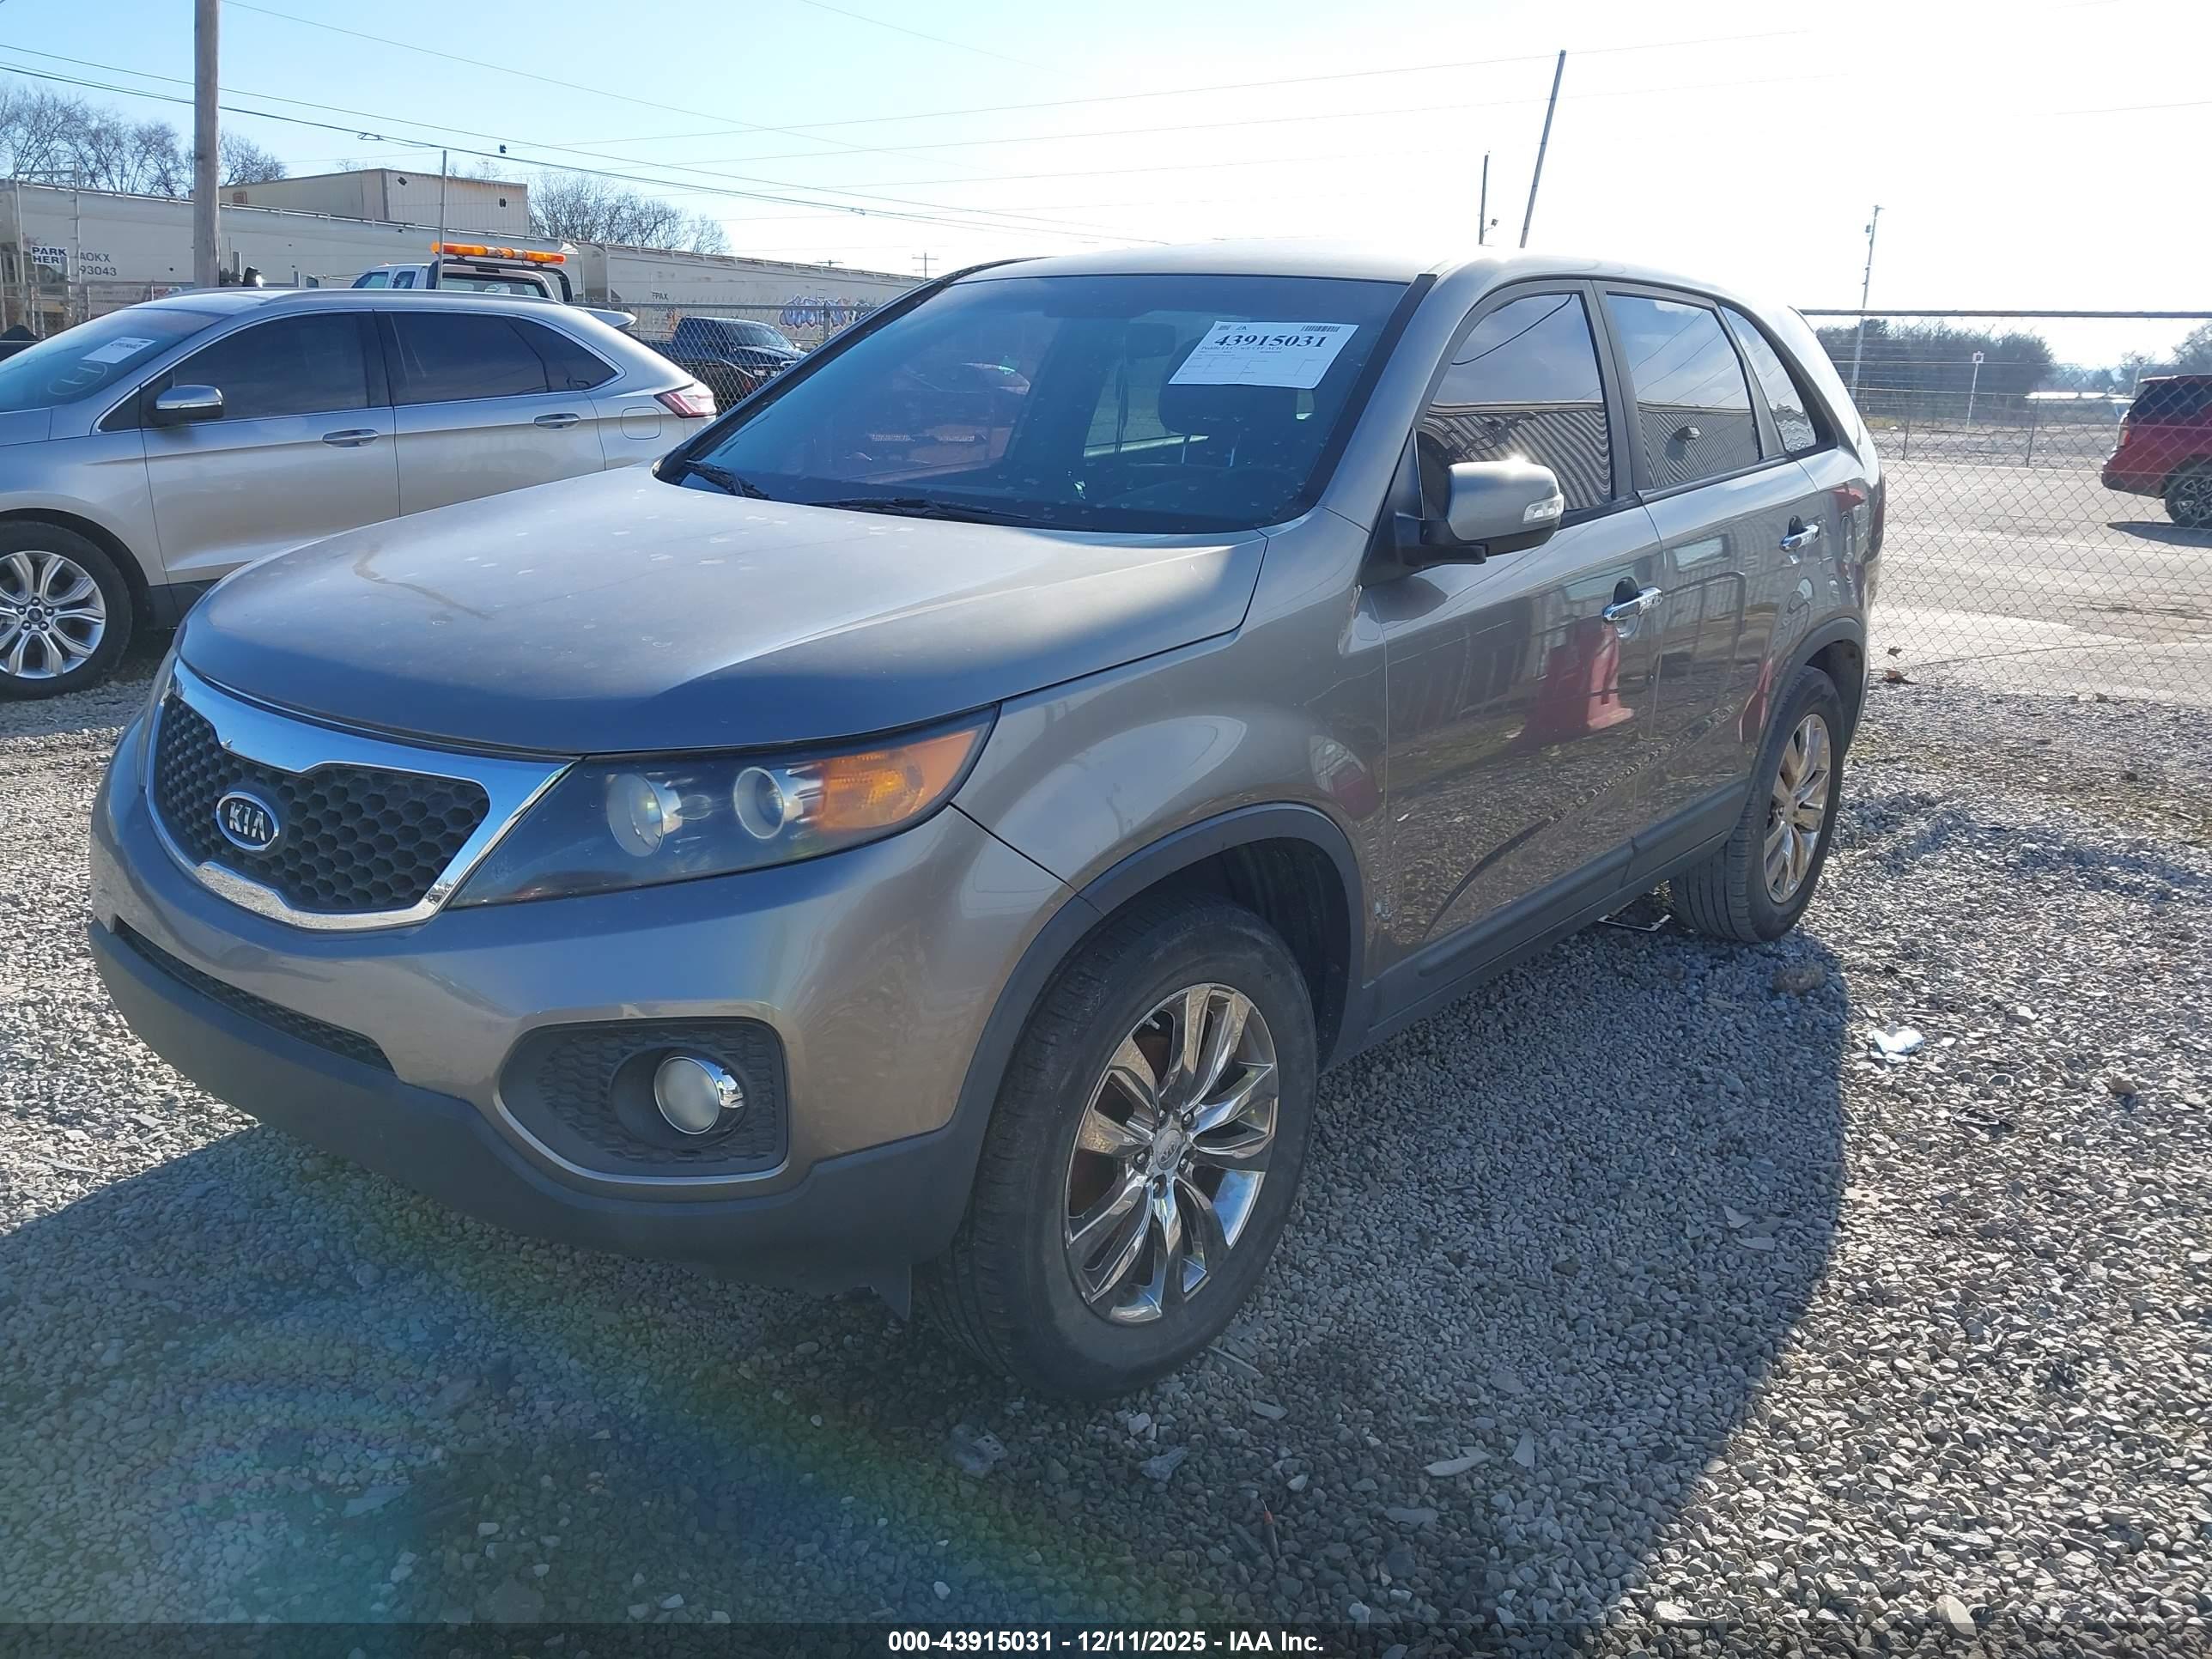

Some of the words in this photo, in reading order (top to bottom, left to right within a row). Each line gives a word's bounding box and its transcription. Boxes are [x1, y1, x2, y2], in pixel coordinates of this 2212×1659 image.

[32, 246, 68, 257] PARK
[79, 252, 111, 263] AOKX
[79, 264, 117, 276] 93043
[1214, 334, 1328, 348] 43915031
[228, 801, 266, 842] KIA
